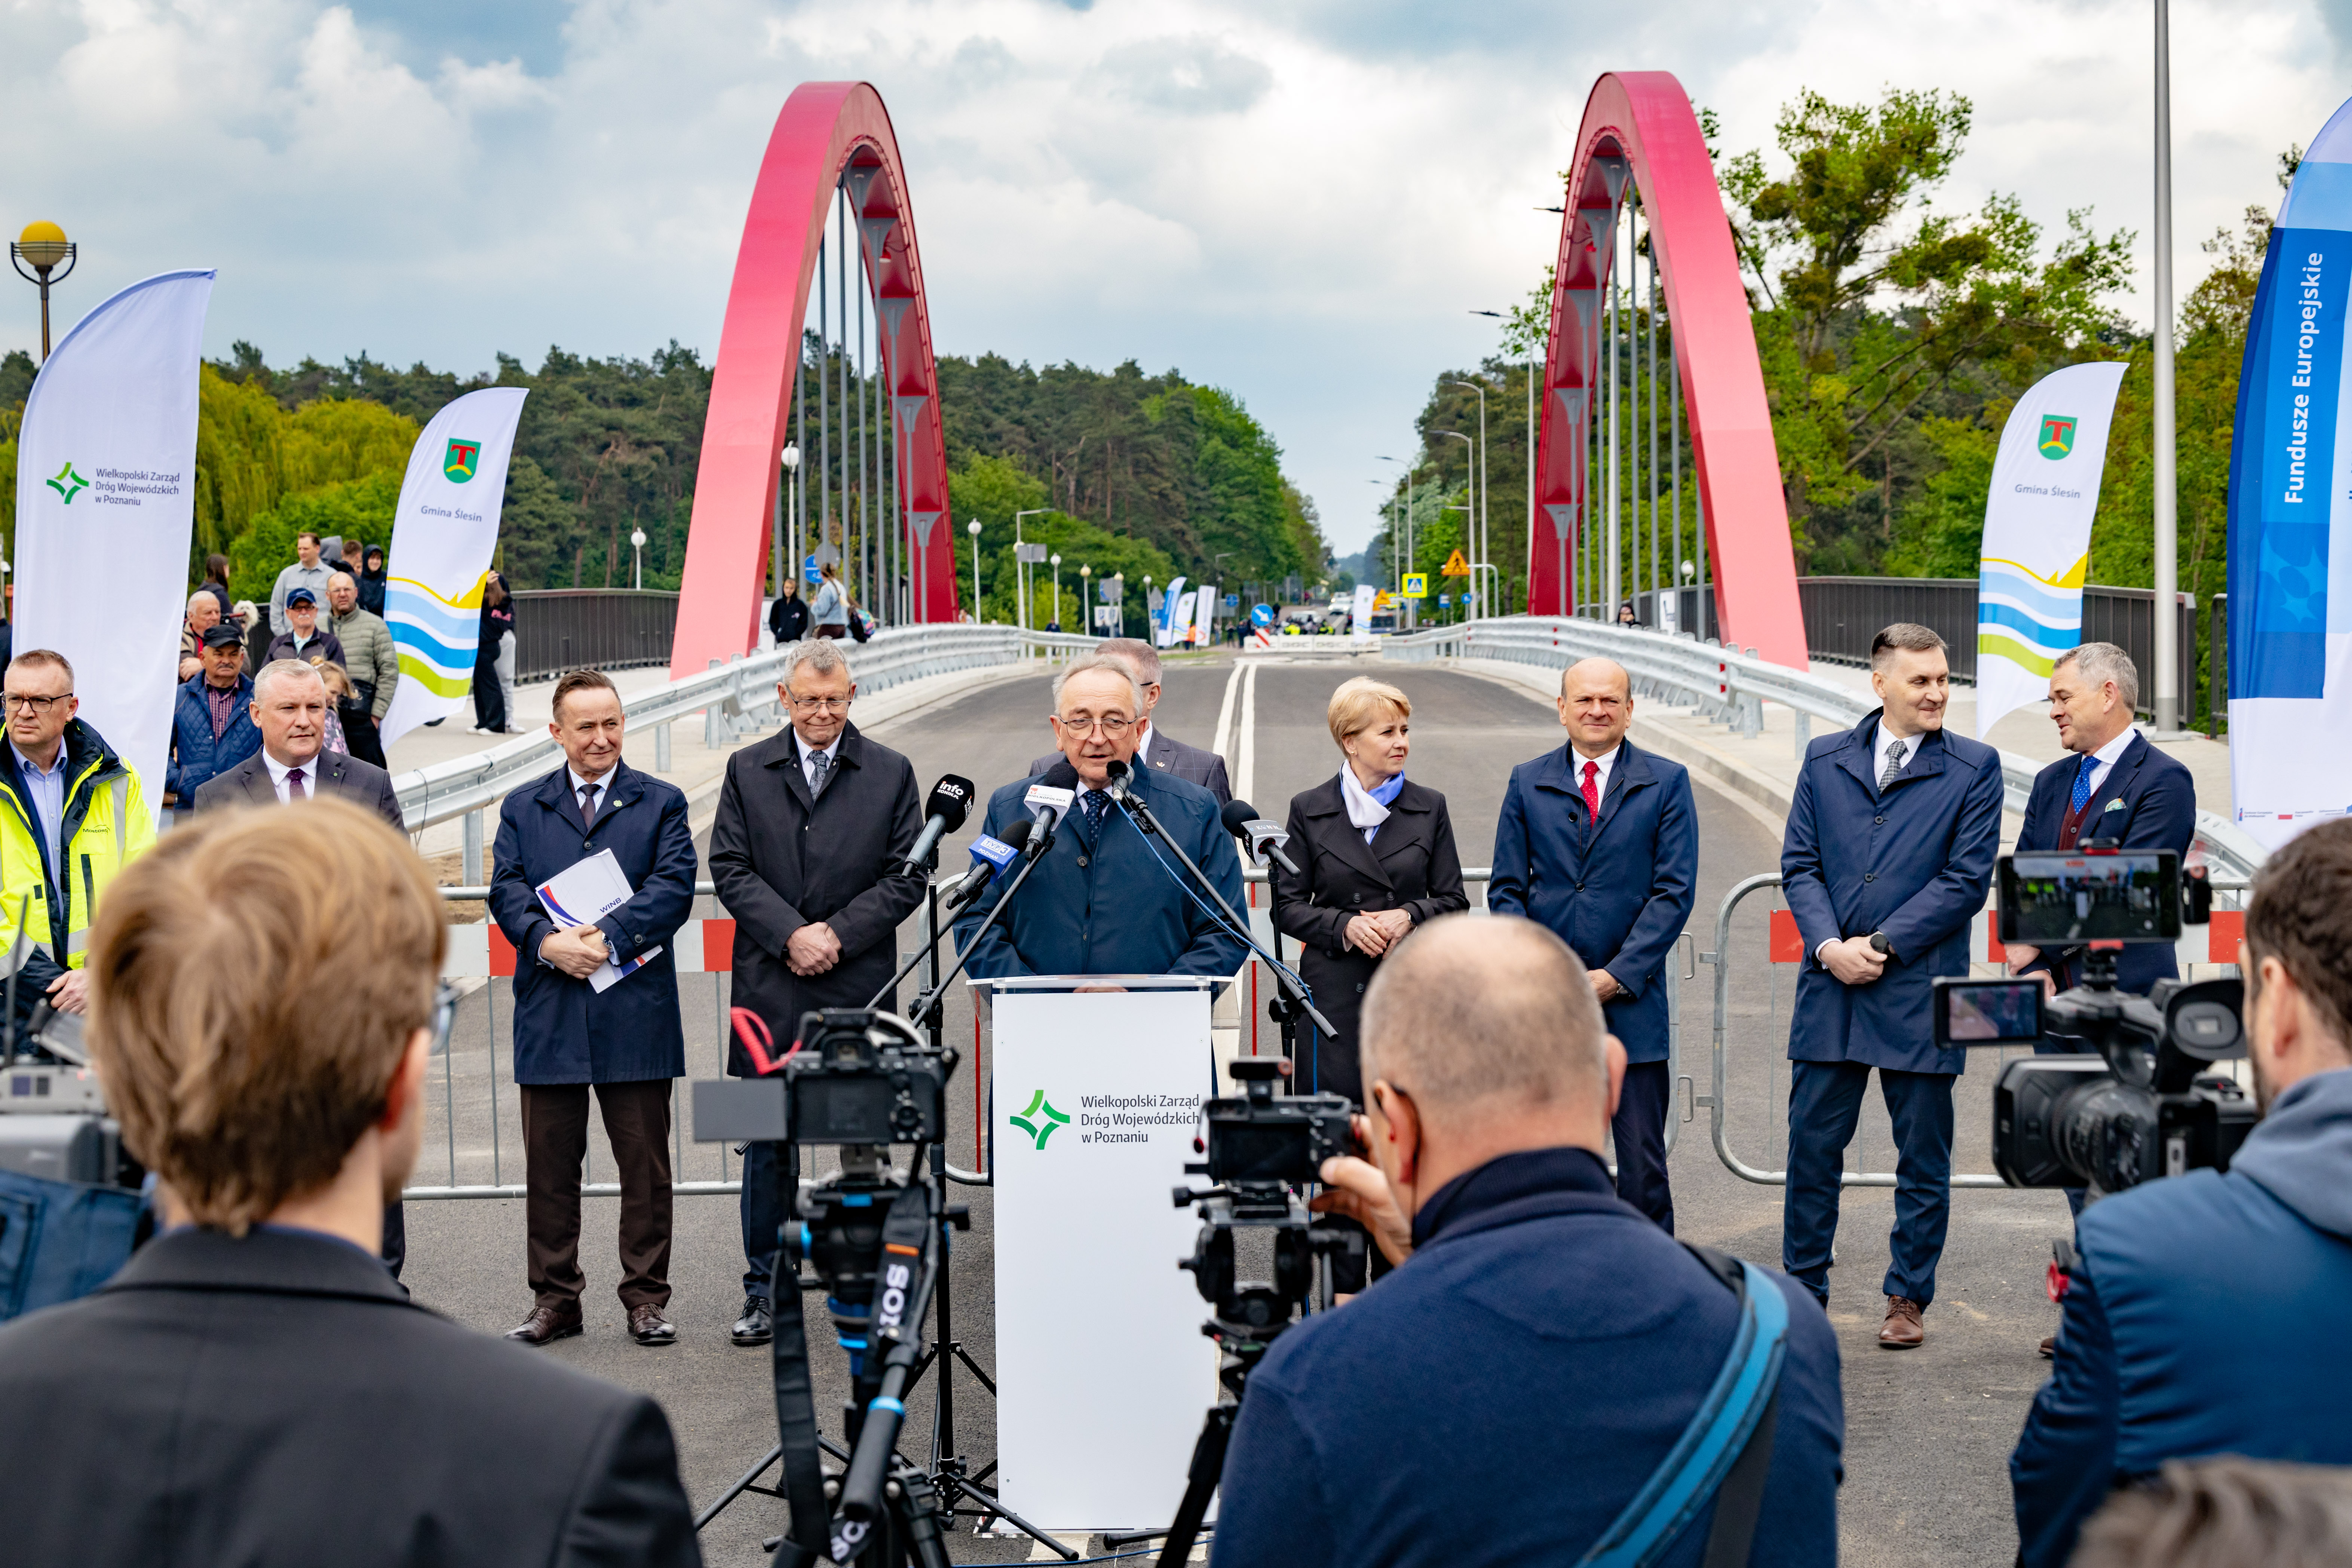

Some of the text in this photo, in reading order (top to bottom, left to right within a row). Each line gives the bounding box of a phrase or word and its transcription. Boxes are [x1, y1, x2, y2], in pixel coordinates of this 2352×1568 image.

[2284, 253, 2323, 503] Fundusze Europejskie
[96, 468, 180, 484] Wielkopolski Zarząd
[96, 481, 179, 494] Dróg Wojewódzkich
[2015, 484, 2080, 498] Gmina Ślesin
[104, 495, 141, 506] Poznaniu
[421, 506, 482, 522] Gmina Ślesin
[937, 789, 959, 800] KONIN.PL
[939, 781, 964, 795] info
[978, 848, 999, 860] POZNAŃ
[600, 897, 622, 913] WINB
[1081, 1094, 1199, 1110] Wielkopolski Zarząd
[1081, 1112, 1199, 1128] Dróg Wojewódzkich
[1082, 1130, 1148, 1143] w Poznaniu
